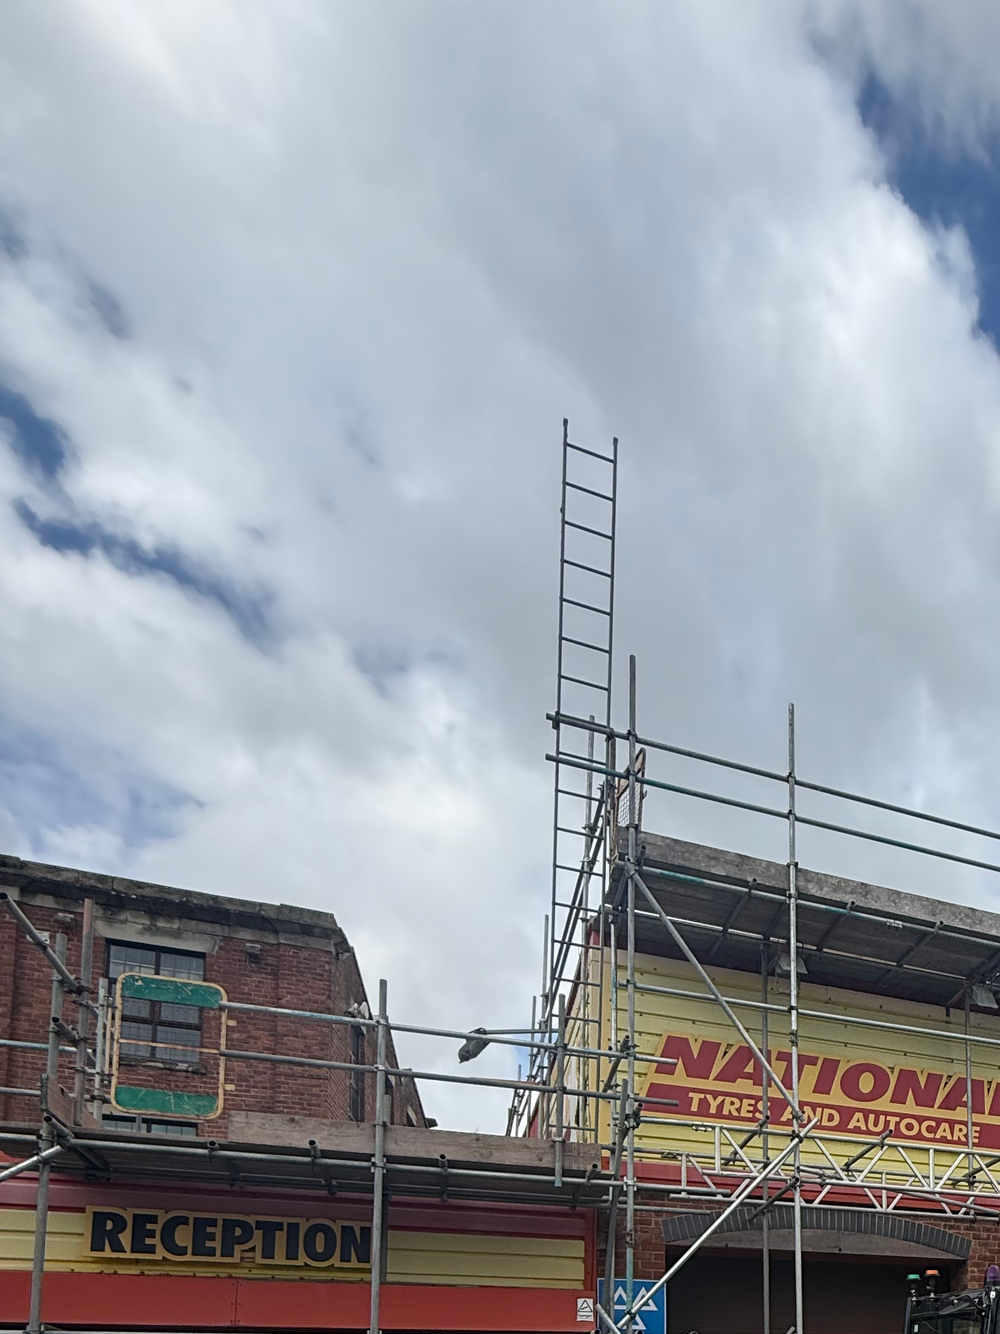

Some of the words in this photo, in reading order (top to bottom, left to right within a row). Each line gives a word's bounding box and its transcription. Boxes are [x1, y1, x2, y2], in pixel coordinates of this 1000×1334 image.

[688, 1091, 772, 1119] TYRES
[782, 1104, 840, 1128] AND
[847, 1113, 981, 1144] AUTOCARE
[90, 1210, 372, 1264] RECEPTION
